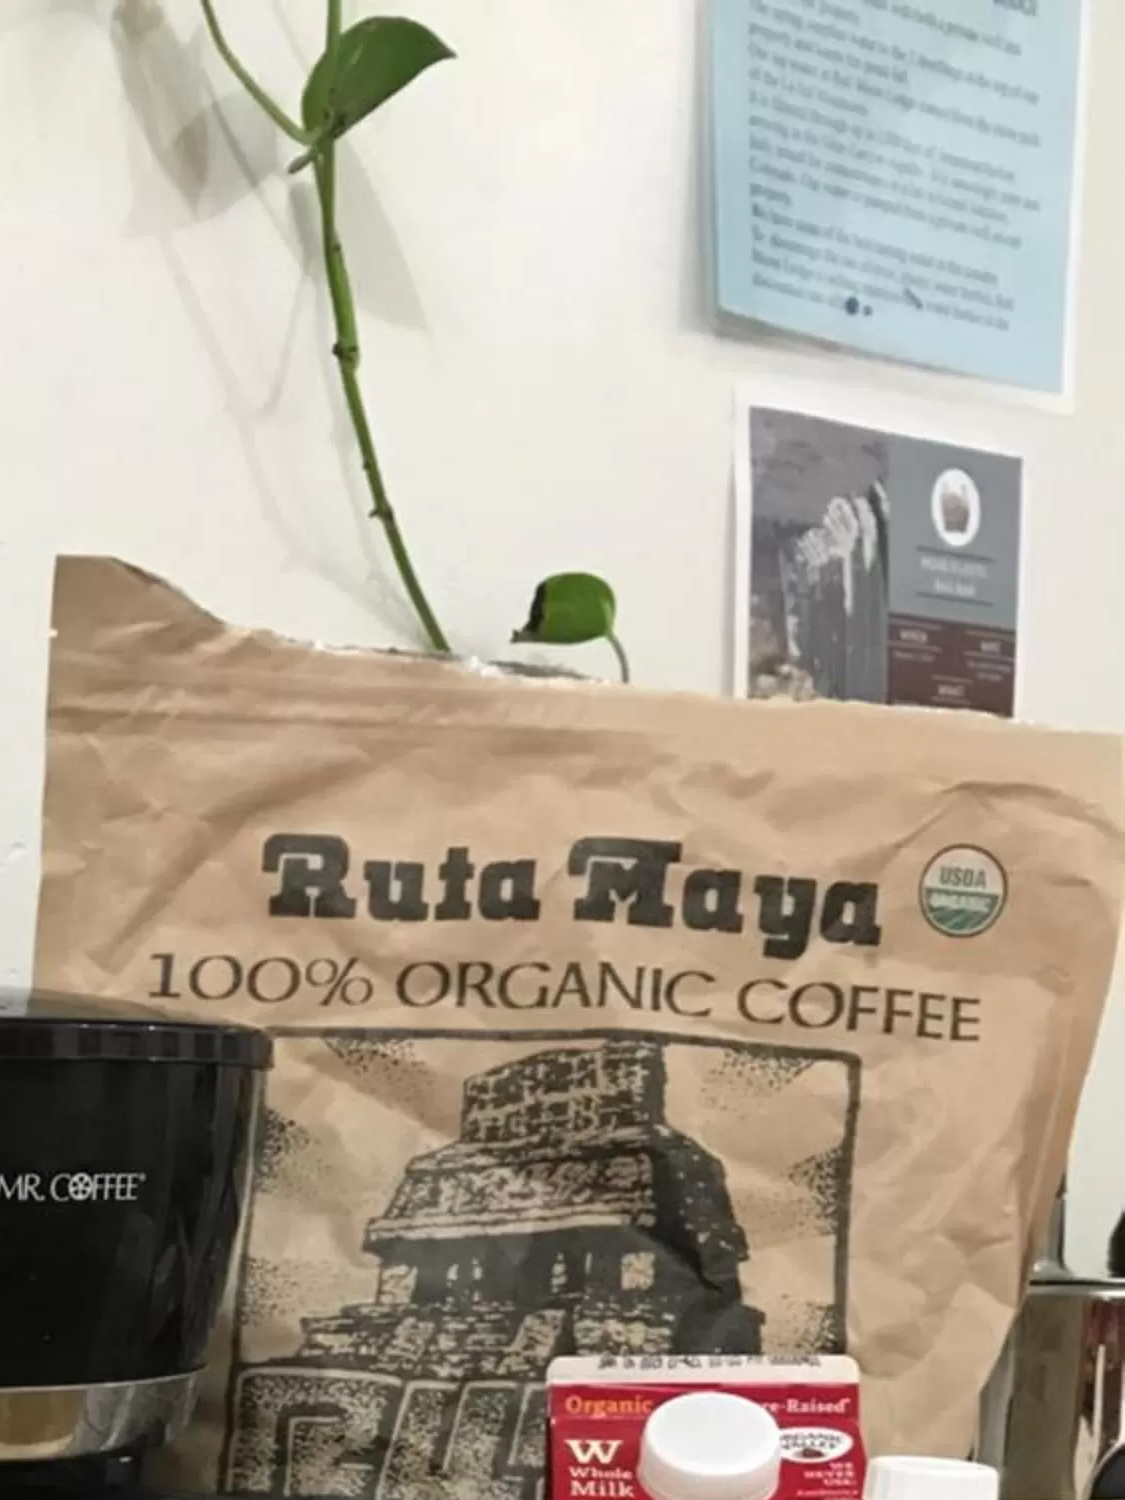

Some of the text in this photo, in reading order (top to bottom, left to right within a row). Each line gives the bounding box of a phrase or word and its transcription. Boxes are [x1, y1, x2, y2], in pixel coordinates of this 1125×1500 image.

[939, 866, 987, 888] USDA
[263, 834, 883, 960] Ruta Maya
[148, 953, 982, 1042] 100% ORGANIC COFFEE
[565, 1395, 653, 1417] Organic
[565, 1439, 623, 1464] W
[569, 1466, 633, 1480] Whole
[570, 1480, 635, 1498] Milk
